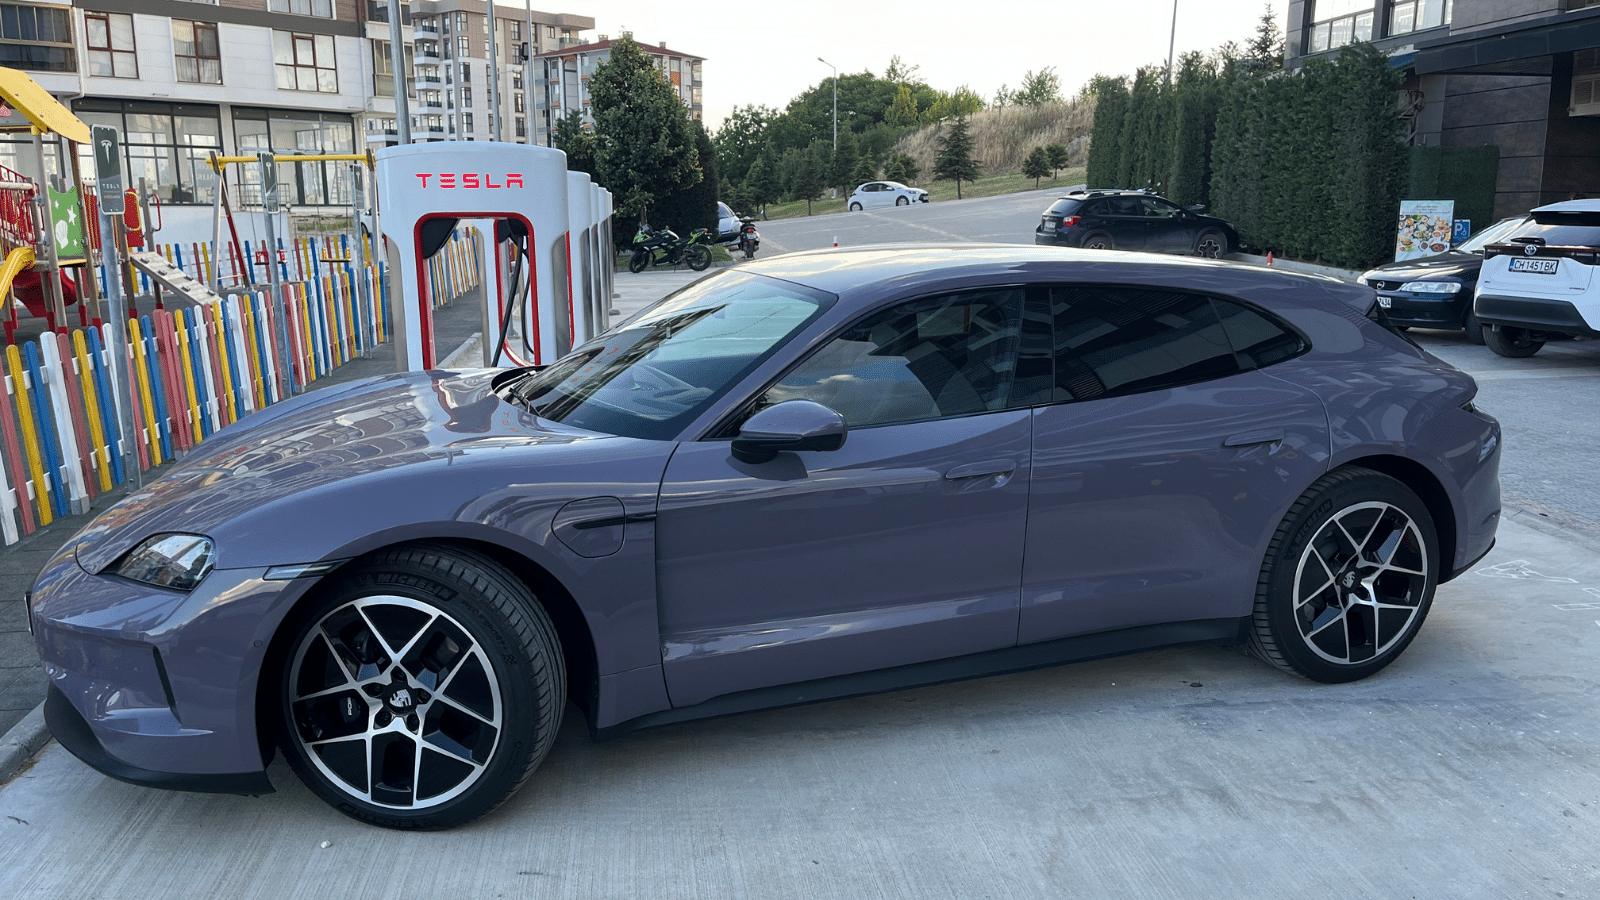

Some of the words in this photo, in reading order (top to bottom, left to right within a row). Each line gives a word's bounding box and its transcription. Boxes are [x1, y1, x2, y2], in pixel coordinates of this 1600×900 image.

[415, 173, 523, 189] TESLA
[1454, 222, 1463, 236] P
[1514, 260, 1524, 270] CH
[1526, 261, 1544, 271] 1451
[1544, 262, 1556, 272] BK
[377, 573, 452, 600] MICHELIN
